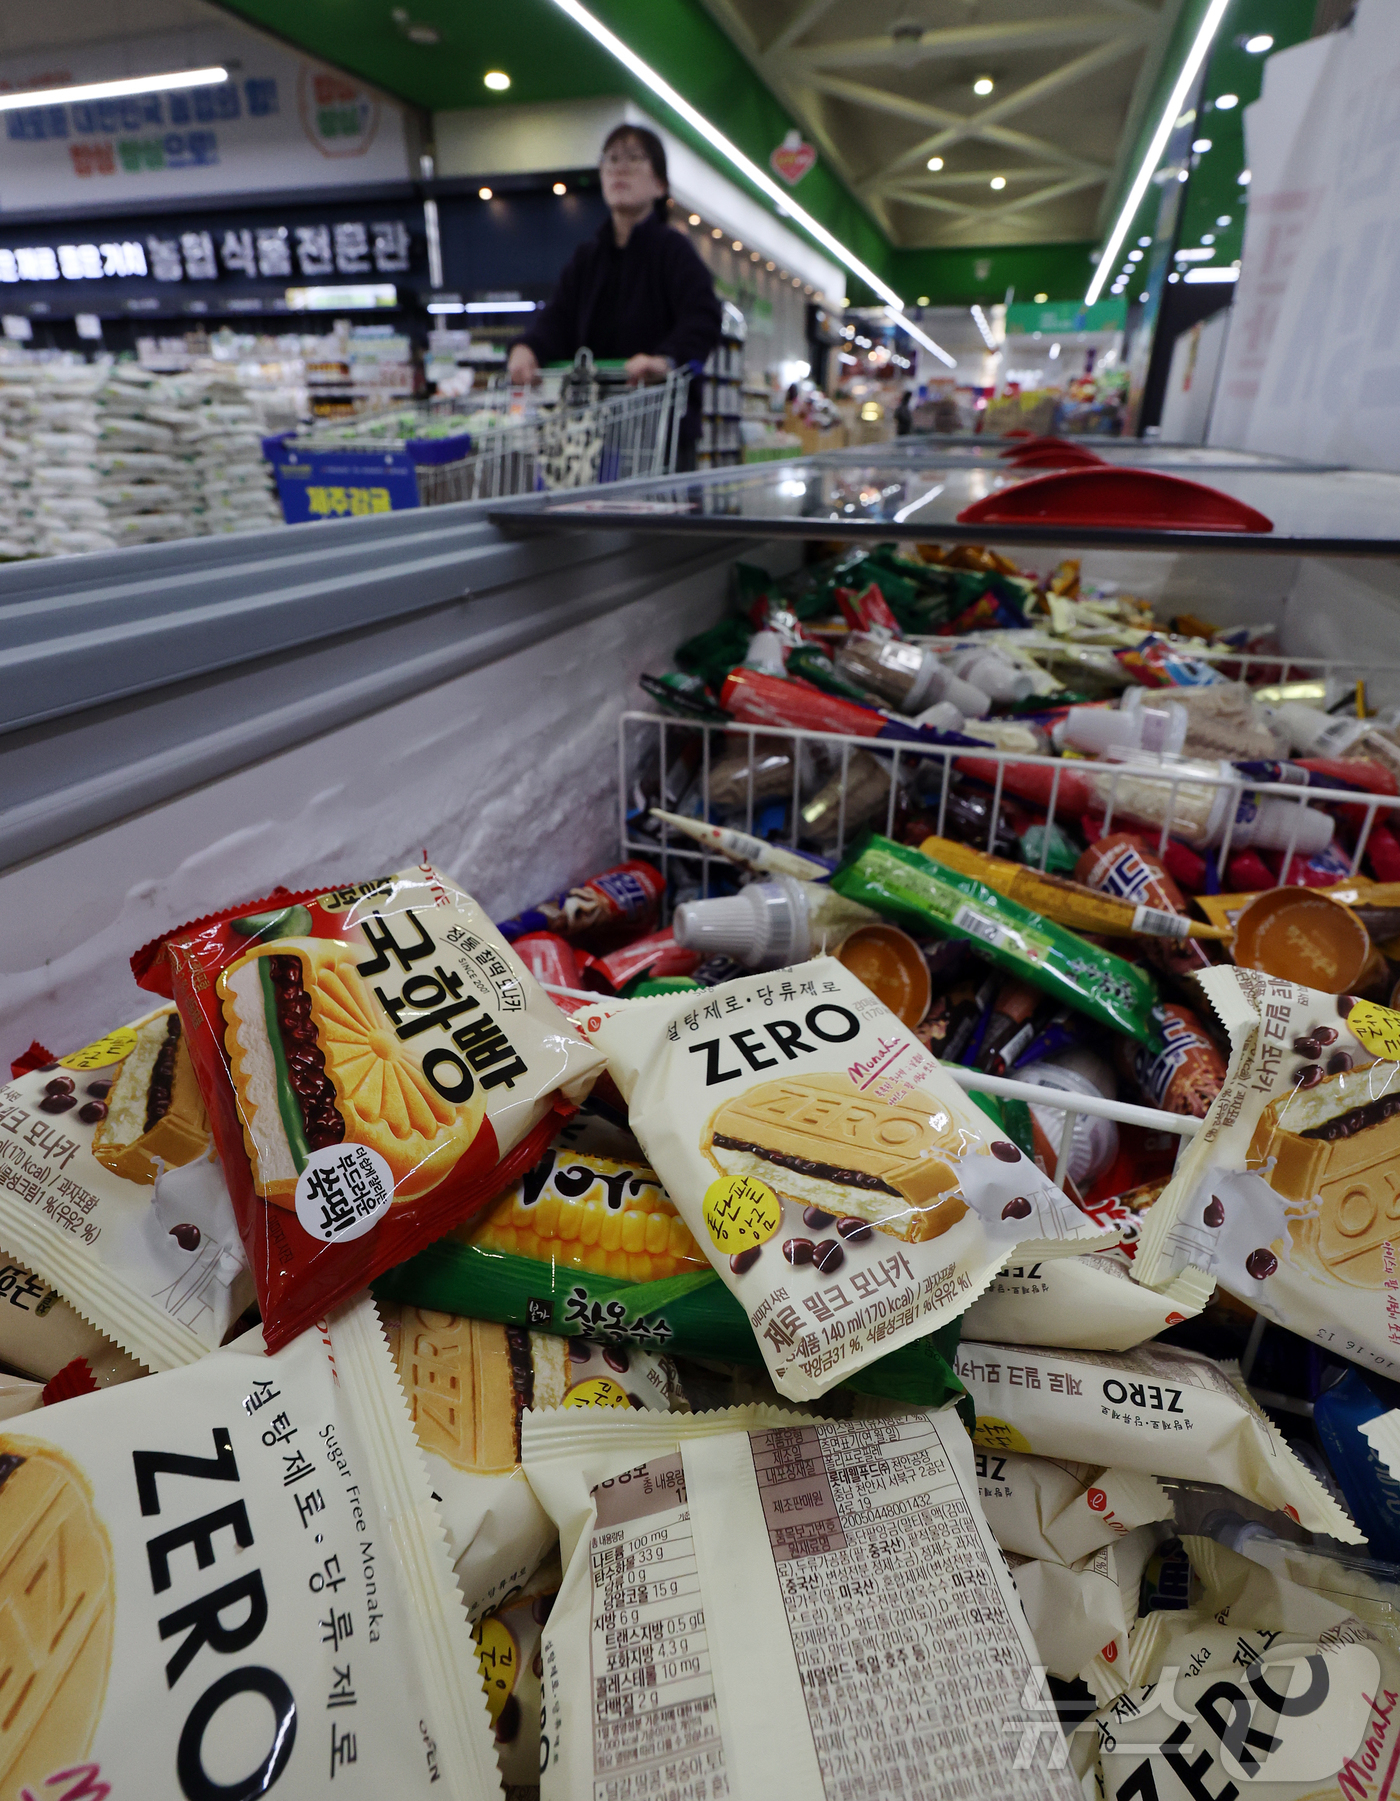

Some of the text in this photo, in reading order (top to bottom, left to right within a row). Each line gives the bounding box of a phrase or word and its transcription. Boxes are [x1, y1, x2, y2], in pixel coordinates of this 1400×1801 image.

[446, 926, 522, 1012] 정통 찰떡 모나카
[458, 957, 490, 995] SINCE 2001
[355, 909, 528, 1104] 국화빵
[1264, 1004, 1291, 1041] 밀크
[689, 1004, 861, 1087] ZERO
[848, 1037, 901, 1085] Monaka
[1251, 1043, 1284, 1094] 모나카
[1222, 1089, 1247, 1128] 과자포함
[23, 1120, 81, 1171] 모나카
[356, 1147, 367, 1159] 더
[21, 1155, 51, 1184] kcal)
[57, 1177, 100, 1216] 과자포함
[337, 1154, 376, 1216] 부드러운
[359, 1157, 377, 1178] 쉽게
[42, 1196, 85, 1234] %(우유2
[80, 1223, 102, 1247] %)
[306, 1166, 356, 1238] 쑥떡!
[707, 1176, 765, 1241] 통단팥
[738, 1209, 776, 1240] 앙금
[565, 1287, 673, 1345] 찰옥수수
[752, 1286, 790, 1329] 이미지 사진
[763, 1250, 915, 1353] 제로 밀크 모나카
[821, 1320, 846, 1346] 140
[847, 1302, 888, 1335] ml(170
[888, 1286, 915, 1314] kcal)
[922, 1261, 957, 1297] 과자포함
[849, 1335, 864, 1354] %,
[865, 1305, 920, 1345] 식물성크림1
[954, 1355, 1083, 1396] 제로 밀크 모나카
[1103, 1379, 1184, 1414] ZERO
[1101, 1405, 1194, 1432] 설탕제로·당류제로
[765, 1444, 883, 1484] 내포장재질 폴리프로필렌
[772, 1426, 900, 1465] 제조일 측면표기(연.월.일)
[891, 1449, 931, 1472] 천안공장
[643, 1476, 653, 1495] 총
[772, 1458, 946, 1514] 제조판매원 충남 천안시 서북구 2공단
[975, 1454, 1008, 1482] ZE
[774, 1493, 933, 1544] 품목보고번호 20050448001432
[838, 1496, 872, 1516] 4로 19
[318, 1424, 382, 1645] Sugar Free Monaka
[593, 1528, 668, 1569] 나트륨 100 mg
[788, 1534, 831, 1559] 원재료명
[241, 1378, 359, 1781] 설탕제로·당류제로
[594, 1546, 664, 1588] 탄수화물 33 g
[604, 1568, 646, 1597] 당류 0 g
[133, 1427, 298, 1801] ZERO
[603, 1581, 678, 1612] 당알코올 15 g
[594, 1609, 639, 1632] 지방 6 g
[605, 1617, 686, 1652] 트랜스지방 0.5
[606, 1638, 688, 1673] 포화지방 4.3 g
[596, 1657, 700, 1701] 콜레스테롤 10 mg
[596, 1690, 659, 1721] 단백질 2 g
[1116, 1654, 1329, 1801] ZERO
[1337, 1688, 1400, 1801] Monaka
[418, 1719, 442, 1784] OPEN
